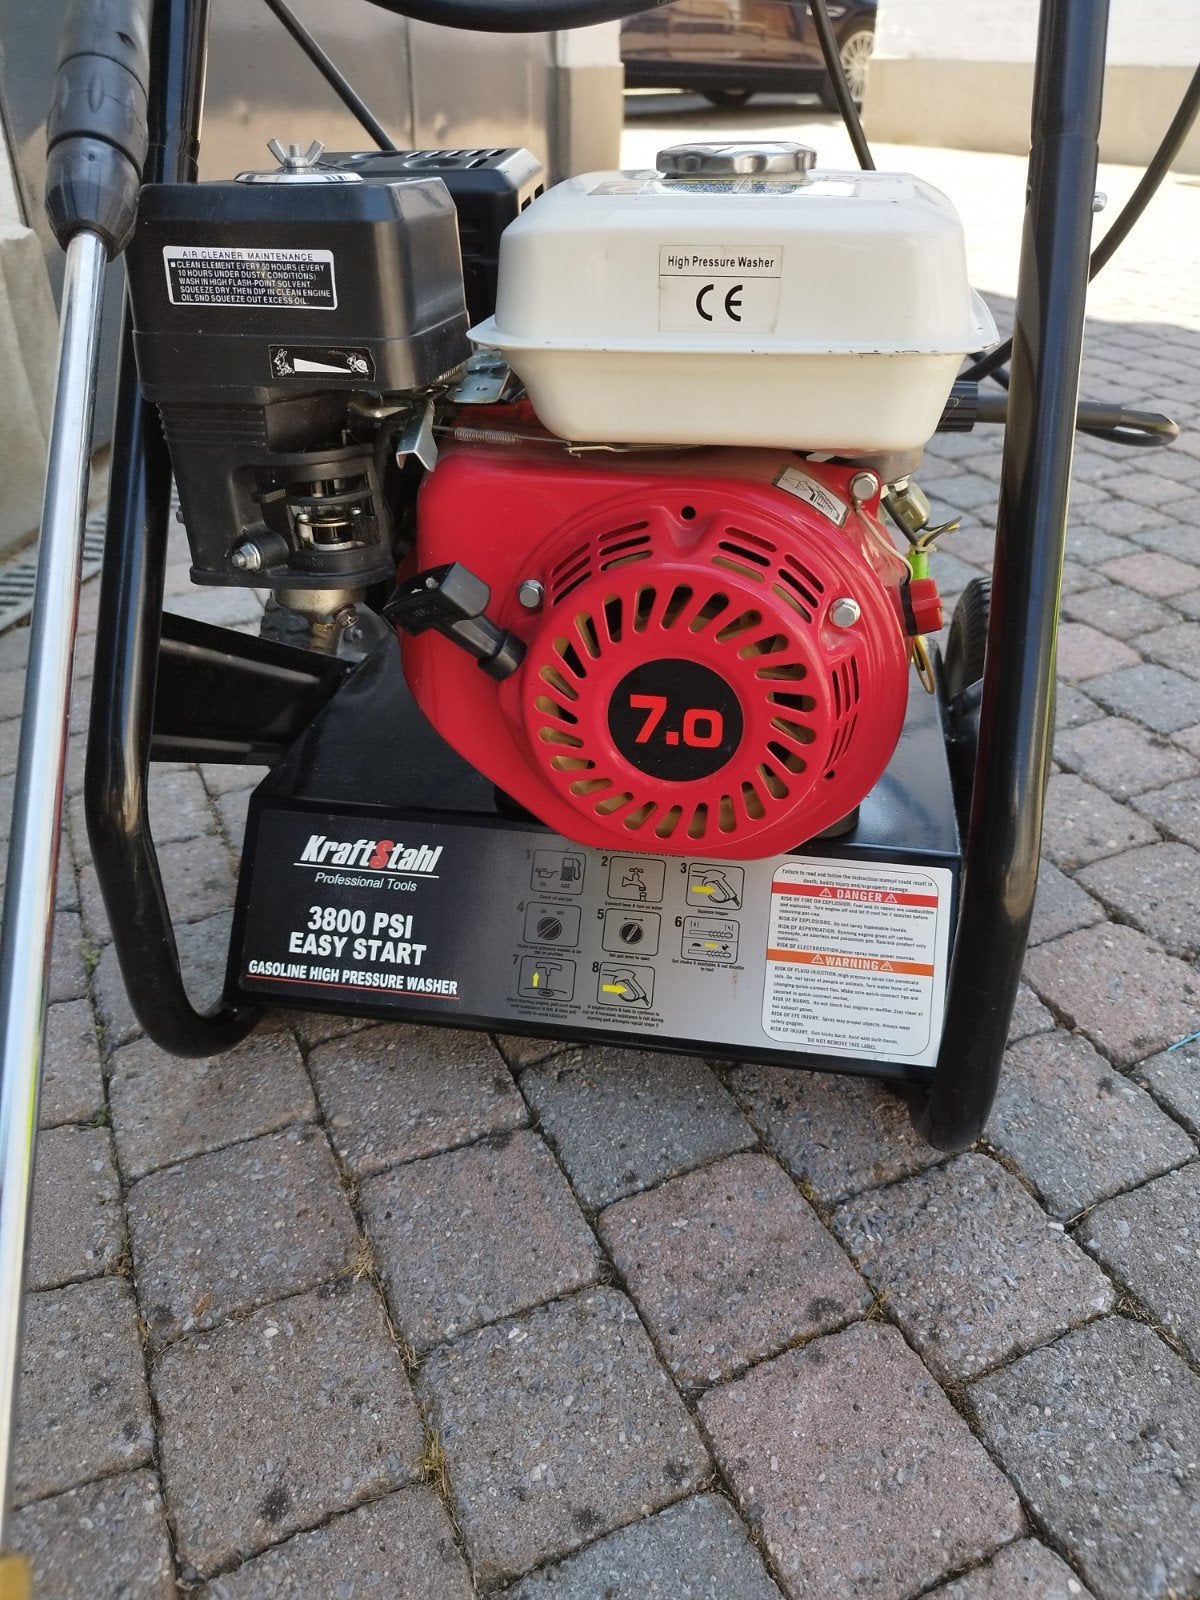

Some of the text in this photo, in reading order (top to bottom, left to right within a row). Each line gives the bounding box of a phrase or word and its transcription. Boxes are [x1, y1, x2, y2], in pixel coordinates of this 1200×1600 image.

[248, 252, 313, 260] MAINTENANCE
[668, 256, 774, 269] High Pressure Washer
[696, 284, 743, 322] CE
[630, 694, 724, 748] 7.0
[300, 835, 444, 872] KraftStahl
[601, 856, 608, 866] 2
[680, 862, 686, 874] 3
[314, 872, 418, 892] Professional Tools
[836, 889, 882, 902] DANGER
[597, 908, 604, 920] 5
[308, 906, 414, 939] 3800 PSI
[674, 916, 682, 928] 6
[288, 932, 428, 966] EASY START
[512, 954, 519, 964] 7
[824, 956, 878, 970] WARNING
[592, 962, 600, 973] 8
[248, 960, 458, 995] GASOLINE HIGH PRESSURE WASHER
